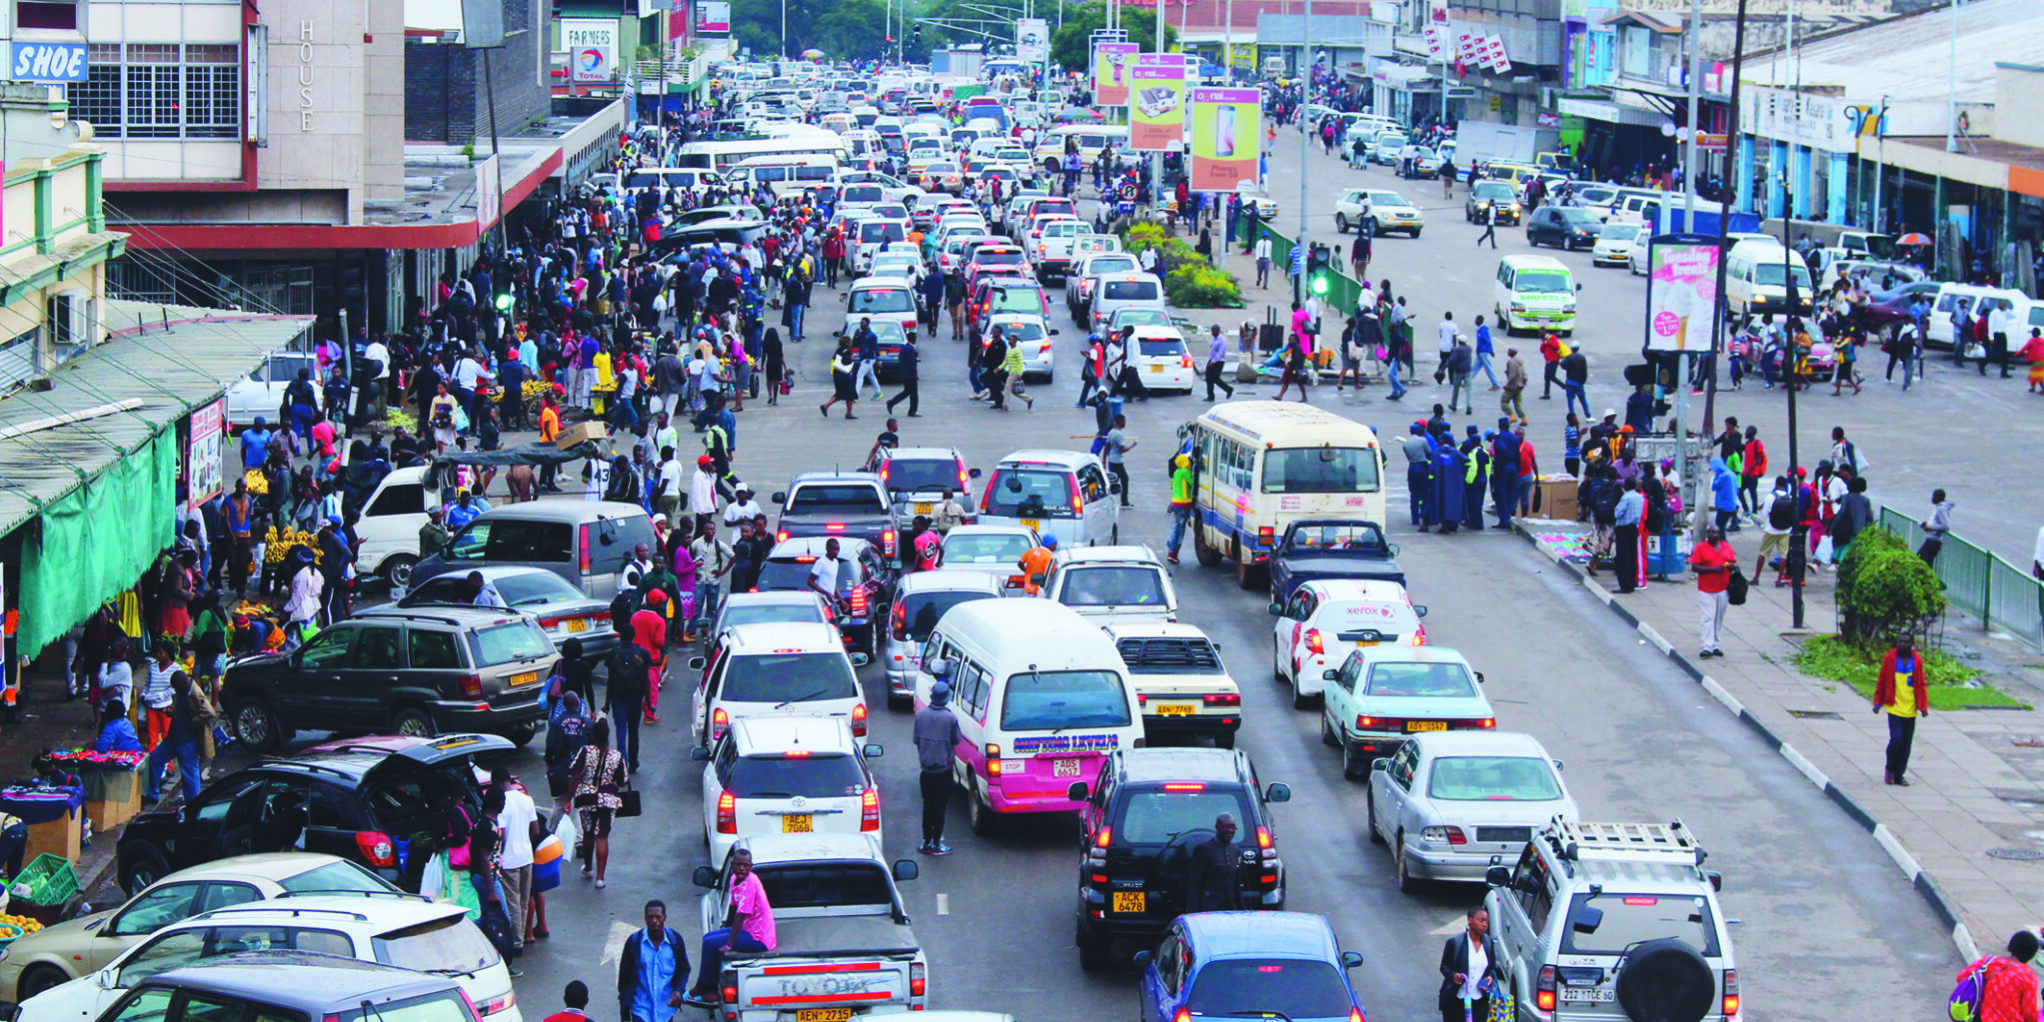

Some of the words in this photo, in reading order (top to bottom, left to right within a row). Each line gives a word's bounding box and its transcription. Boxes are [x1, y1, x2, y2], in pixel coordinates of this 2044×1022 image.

[569, 30, 610, 45] FARMERS
[14, 46, 85, 78] SHOE
[300, 20, 313, 132] HOUSE
[578, 72, 605, 80] TOTAL
[1659, 246, 1711, 264] Tuesday
[1673, 263, 1708, 275] treats
[594, 468, 609, 482] 43
[1060, 759, 1076, 767] ADS
[1057, 767, 1078, 776] 6617
[789, 815, 806, 823] AEJ
[788, 824, 810, 832] 7068
[1121, 893, 1139, 901] ACK
[1118, 902, 1143, 911] 6478
[778, 978, 870, 996] TOYOTA
[800, 1011, 818, 1021] AEN
[825, 1010, 849, 1020] 2715
